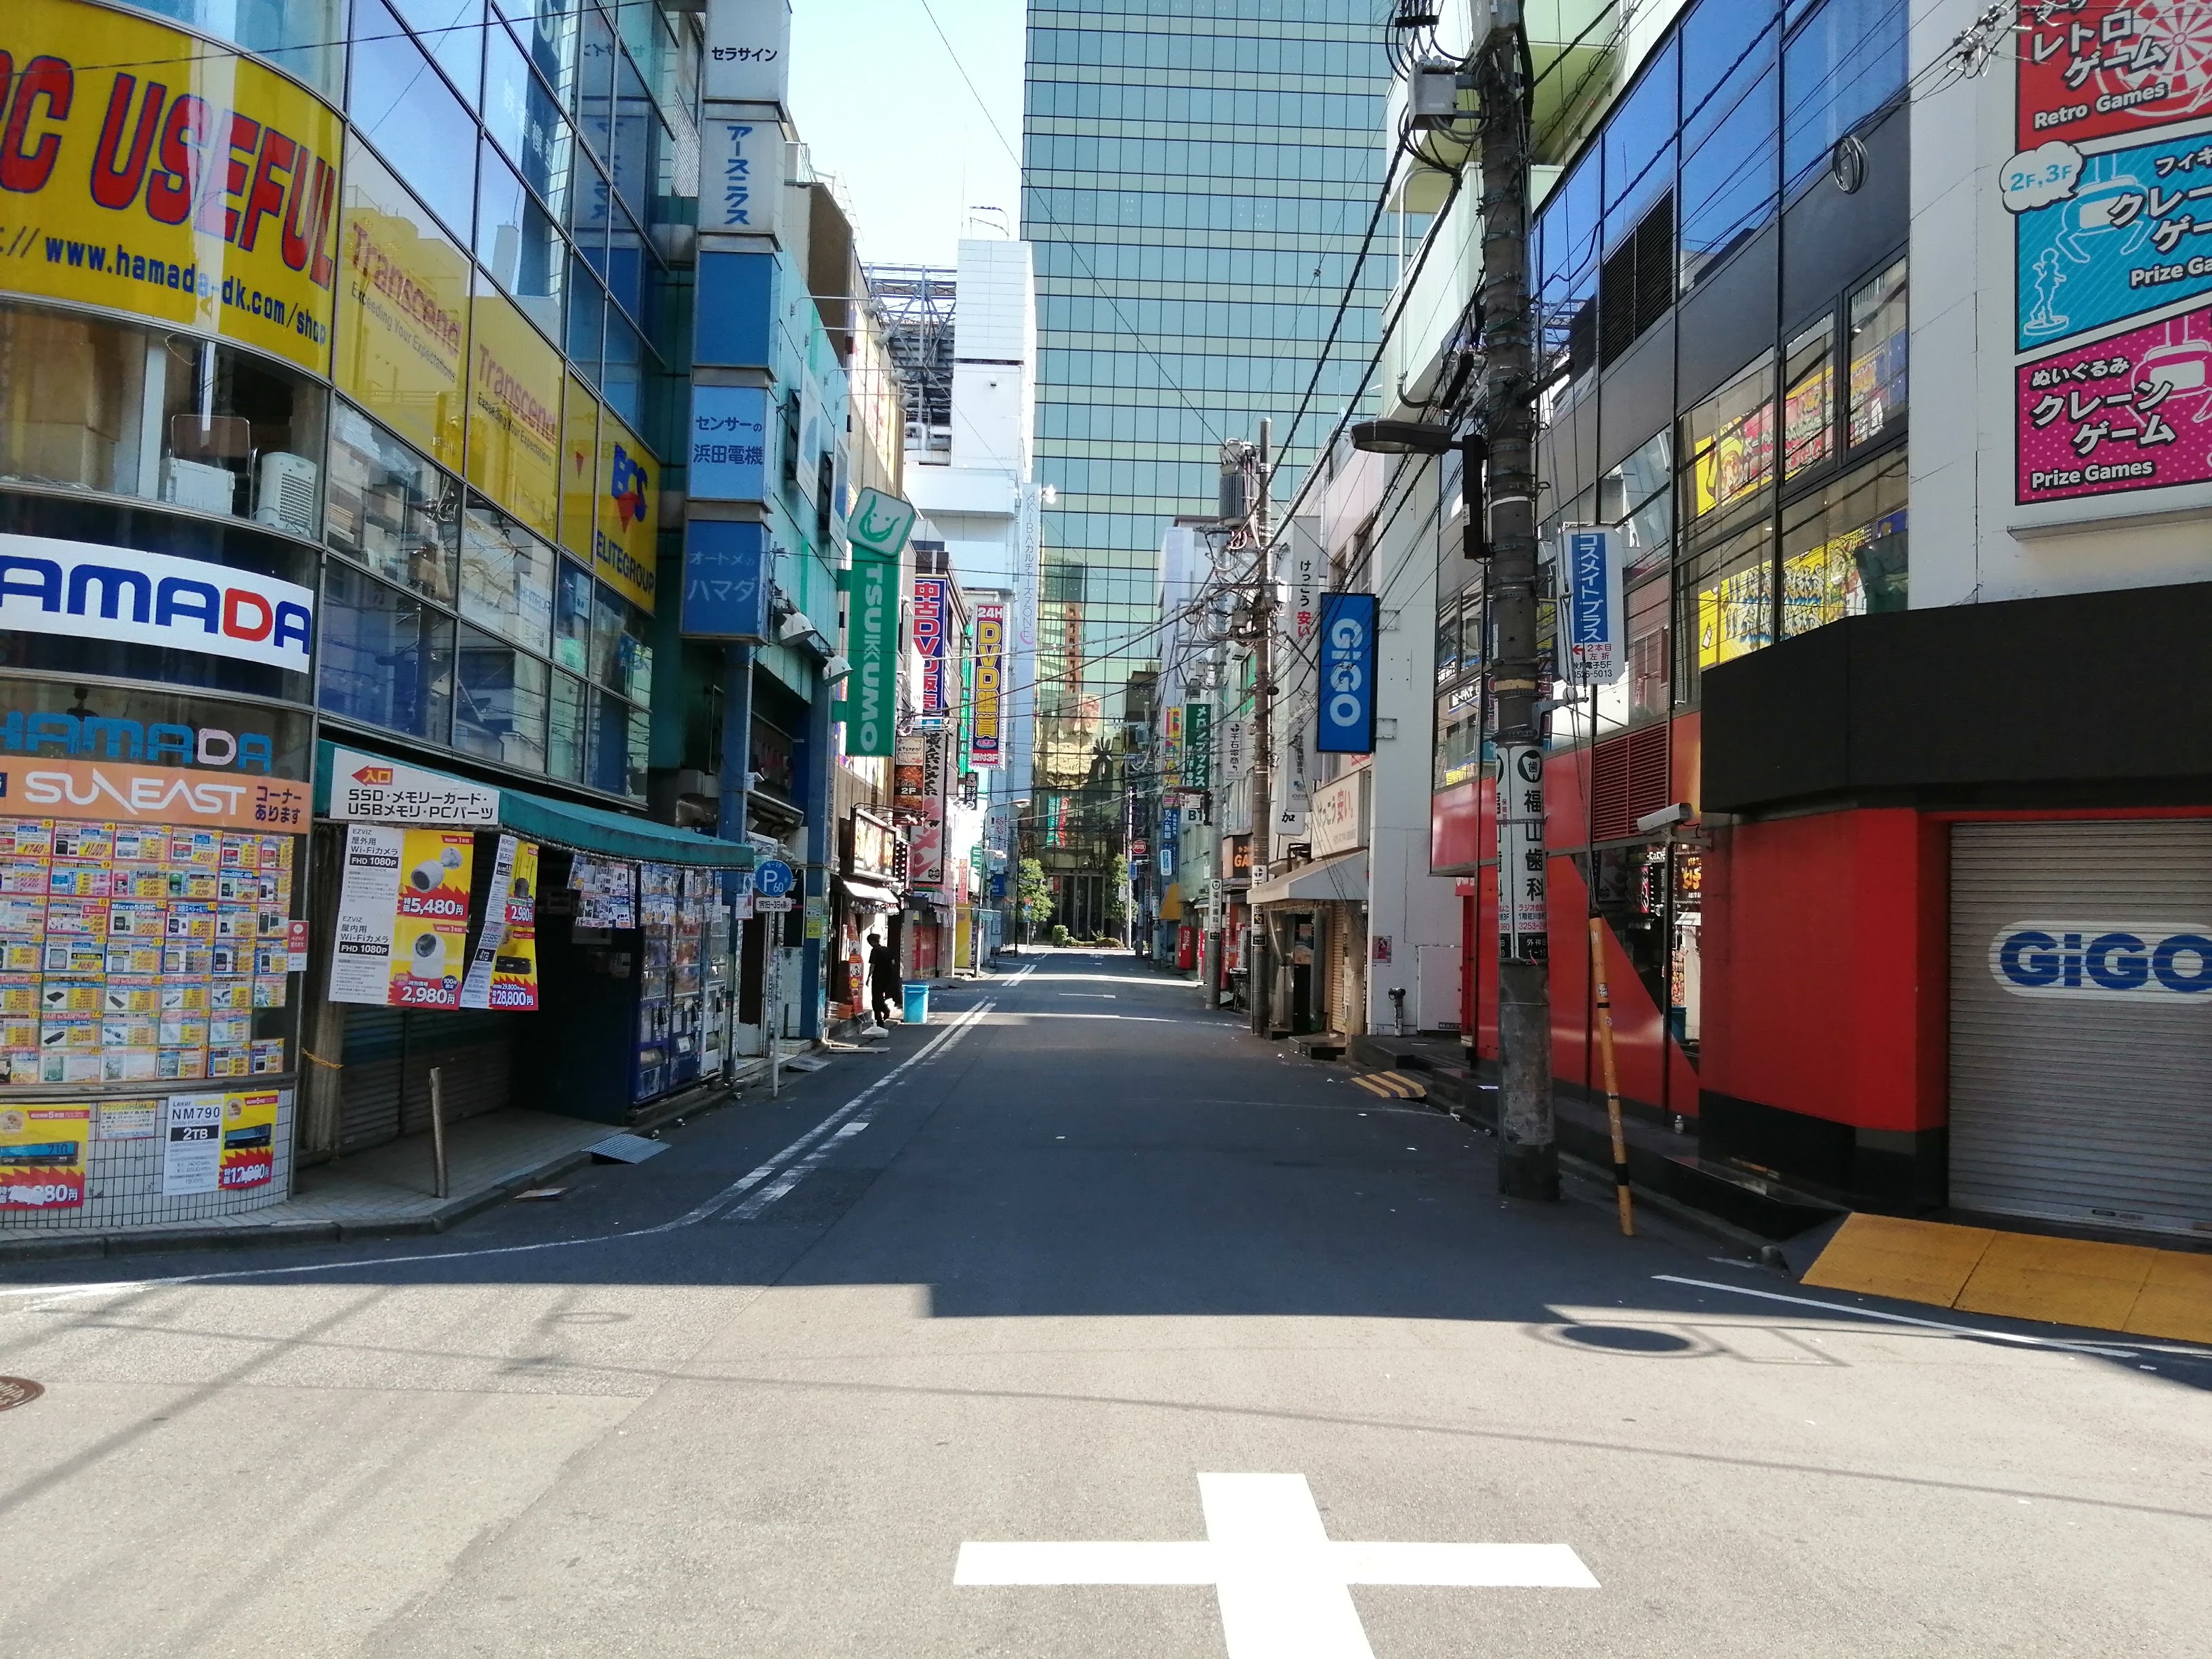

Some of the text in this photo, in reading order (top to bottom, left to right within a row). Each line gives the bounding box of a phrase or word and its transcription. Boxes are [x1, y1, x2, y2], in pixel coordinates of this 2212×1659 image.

[2034, 9, 2133, 62] レトロ
[712, 47, 777, 62] セラサイン
[2064, 37, 2167, 88] ゲーム
[2034, 84, 2166, 129] Retro Games
[91, 73, 336, 291] USEFUL
[724, 126, 753, 225] アースニクス
[2131, 265, 2184, 286] Prize
[352, 221, 462, 359] Transcend
[351, 281, 456, 384] Exceeding Your Expectations
[2032, 358, 2129, 387] ぬいぐるみ
[478, 343, 556, 444] Transcend
[2033, 381, 2172, 426] クレーン
[695, 415, 763, 434] センサーの
[2073, 415, 2176, 455] ゲーム
[693, 444, 764, 466] 浜田電機
[2032, 461, 2153, 489] Prize Games
[596, 531, 655, 594] ELITEGROUP
[689, 551, 755, 567] オートメの
[688, 576, 759, 603] ハマダ
[1578, 535, 1604, 642] コスメイトプラス
[978, 607, 1003, 619] 24H
[859, 562, 884, 752] TSUKUMO
[1587, 643, 1612, 652] 2本目
[363, 771, 392, 784] 入口
[255, 785, 302, 802] コーナー
[255, 804, 301, 825] あります
[351, 836, 377, 846] 屋外用
[1524, 790, 1544, 901] 福山歯科
[763, 869, 784, 893] P 60
[341, 924, 367, 933] 屋内用
[341, 945, 358, 953] FHD
[171, 1106, 220, 1120] NM790
[183, 1128, 208, 1141] 2TB
